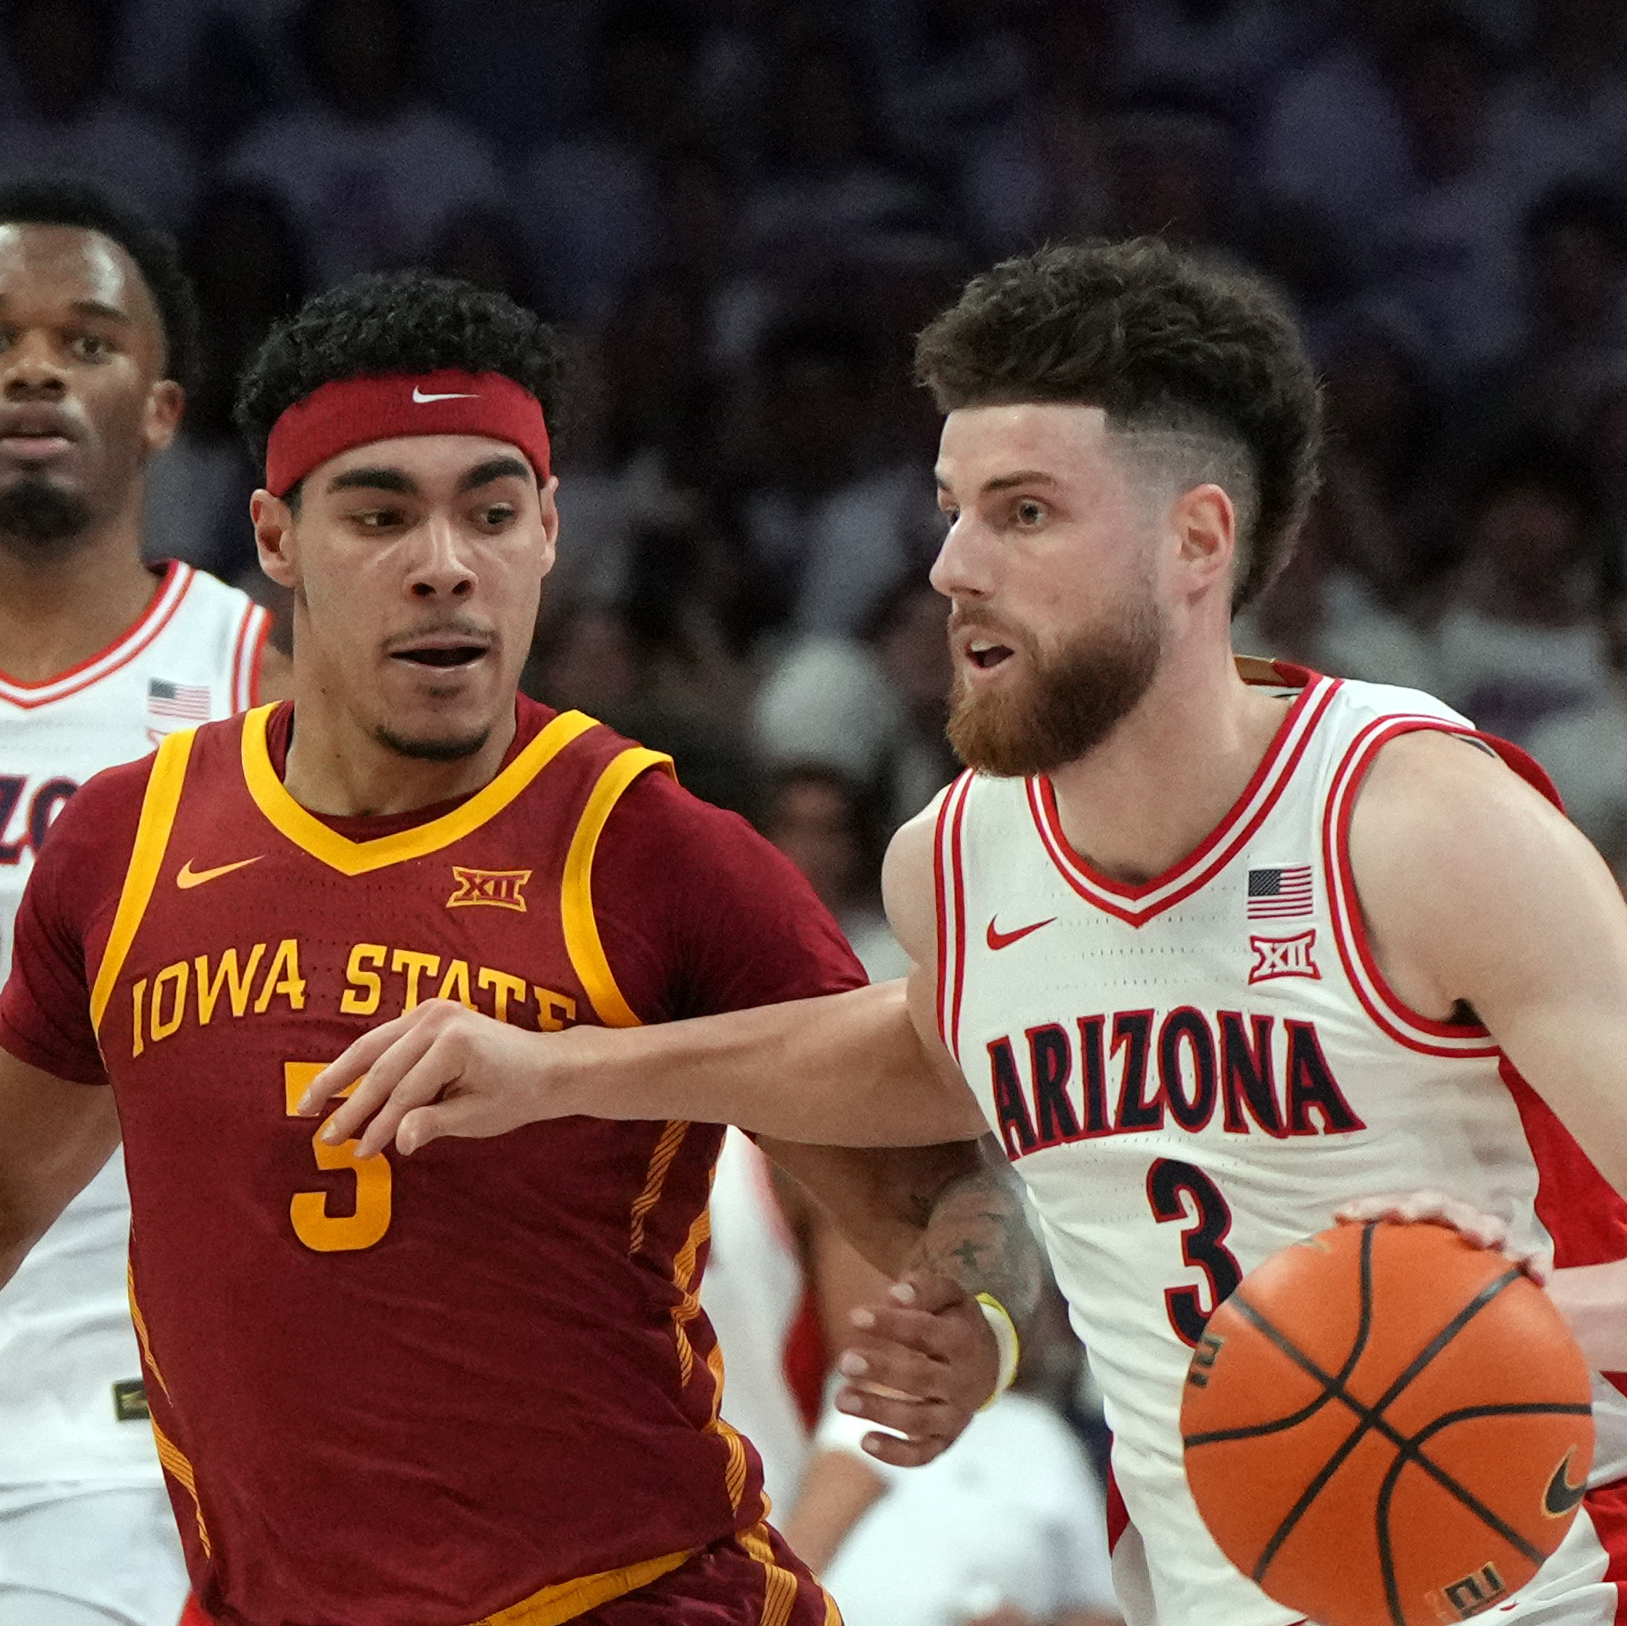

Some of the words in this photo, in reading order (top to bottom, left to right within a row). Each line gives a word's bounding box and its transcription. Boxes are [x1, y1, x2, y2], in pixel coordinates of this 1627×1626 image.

[131, 938, 306, 1058] IOWA
[986, 1004, 1367, 1162] ARIZONA
[1145, 1157, 1244, 1349] 3
